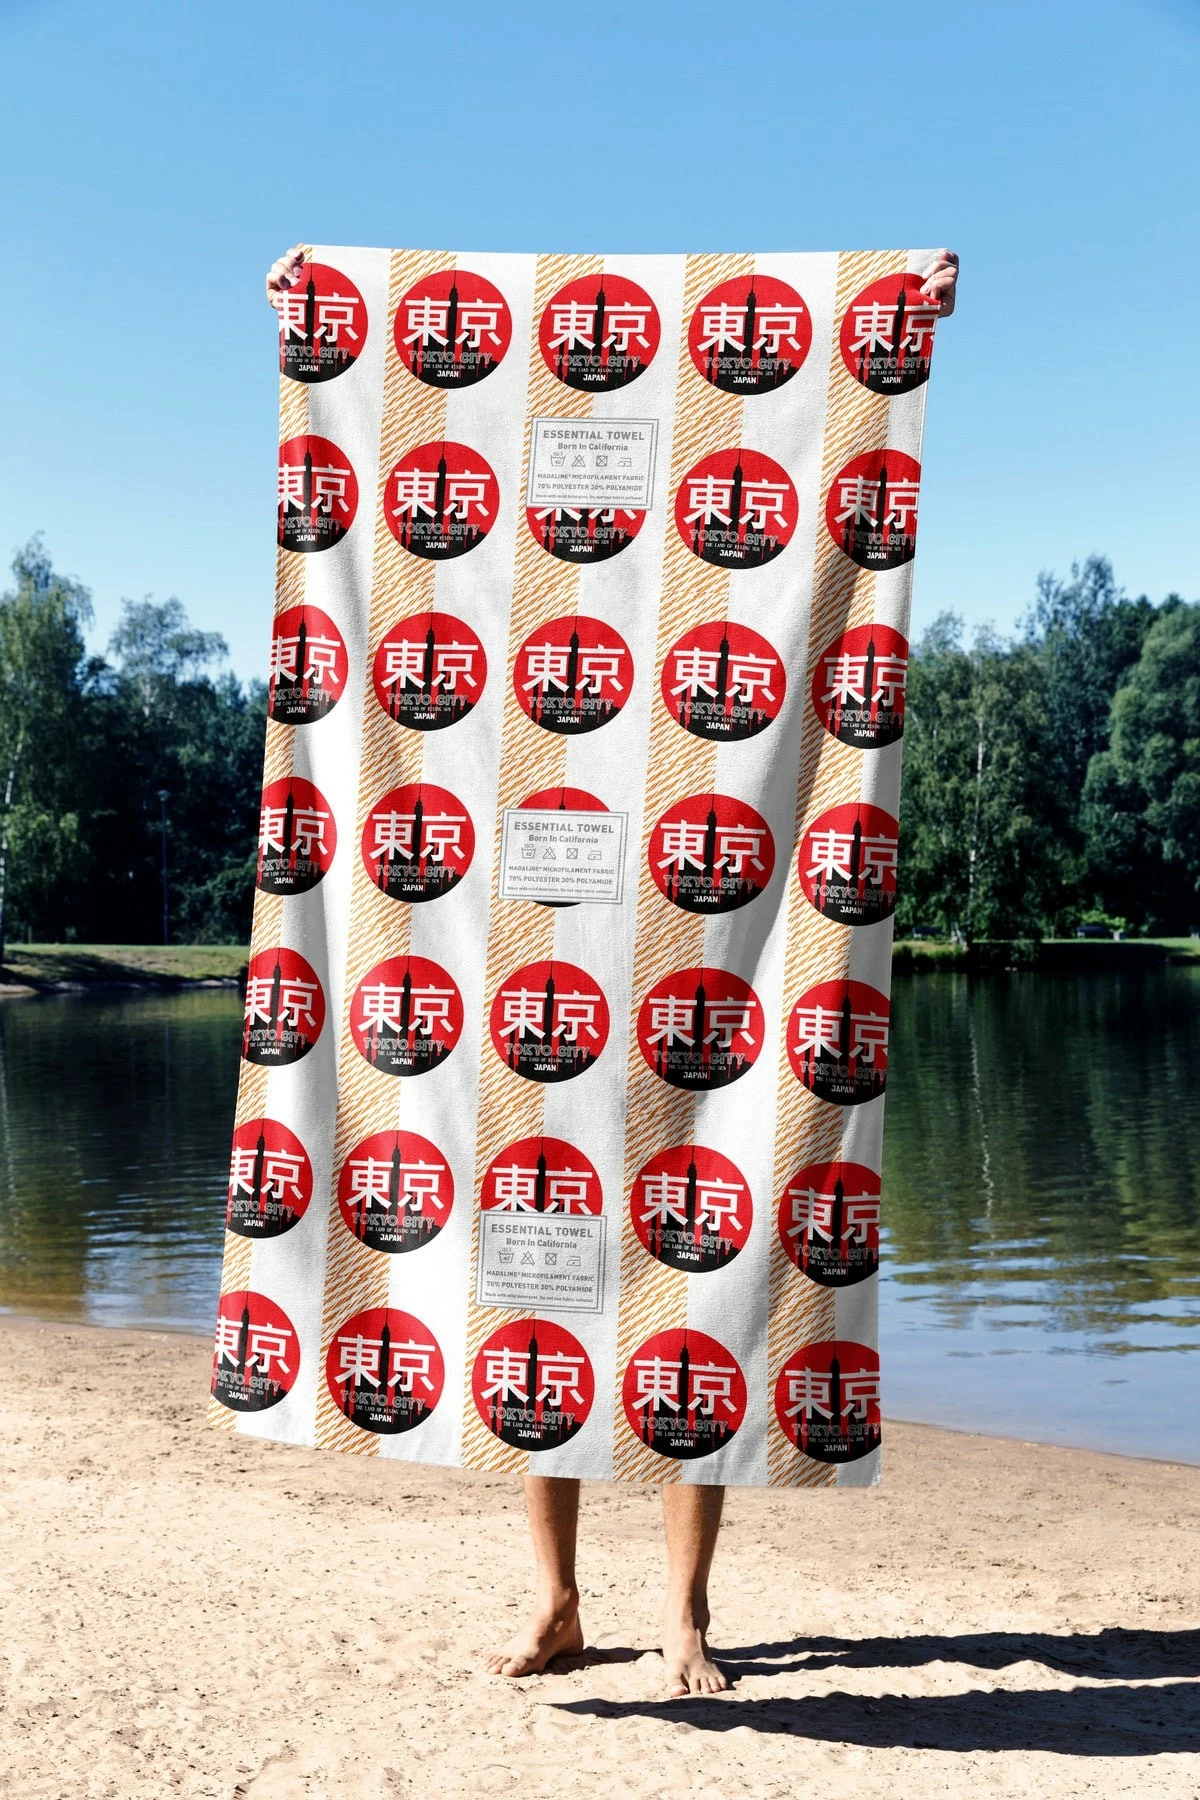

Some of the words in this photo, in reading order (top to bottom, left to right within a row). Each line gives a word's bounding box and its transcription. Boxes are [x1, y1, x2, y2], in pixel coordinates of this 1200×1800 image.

[402, 296, 503, 348] 東京
[548, 300, 652, 351] 東京
[697, 302, 803, 353] 東京
[408, 351, 454, 363] TOKYO
[460, 352, 492, 364] CITY
[554, 355, 601, 367] TOKYO
[607, 355, 640, 367] CITY
[703, 358, 752, 369] TOKYO
[758, 358, 792, 370] CITY
[297, 364, 318, 372] JAPAN
[543, 430, 603, 439] ESSENTIAL
[608, 432, 644, 440] TOWEL
[392, 468, 490, 519] 東京
[684, 474, 790, 529] 東京
[398, 522, 443, 534] TOKYO
[448, 523, 480, 535] CITY
[540, 526, 588, 538] TOKYO
[594, 527, 627, 539] CITY
[296, 535, 315, 543] JAPAN
[690, 529, 738, 544] TOKYO
[744, 532, 778, 546] CITY
[720, 550, 743, 559] JAPAN
[866, 551, 886, 559] JAPAN
[380, 638, 478, 690] 東京
[522, 642, 625, 694] 東京
[670, 647, 777, 702] 東京
[386, 694, 431, 706] TOKYO
[436, 694, 468, 706] CITY
[528, 697, 575, 709] TOKYO
[581, 698, 614, 710] CITY
[676, 701, 725, 717] TOKYO
[731, 706, 766, 720] CITY
[706, 722, 730, 732] JAPAN
[854, 730, 874, 738] JAPAN
[514, 822, 573, 832] ESSENTIAL
[577, 824, 614, 833] TOWEL
[369, 810, 466, 861] 東京
[657, 820, 766, 873] 東京
[375, 865, 419, 877] TOKYO
[425, 866, 456, 878] CITY
[276, 877, 293, 886] JAPAN
[663, 875, 714, 889] TOKYO
[720, 877, 755, 891] CITY
[694, 895, 718, 904] JAPAN
[840, 905, 861, 914] JAPAN
[358, 982, 455, 1035] 東京
[498, 987, 600, 1041] 東京
[645, 994, 756, 1048] 東京
[363, 1038, 408, 1051] TOKYO
[413, 1039, 445, 1052] CITY
[505, 1043, 552, 1057] TOKYO
[557, 1045, 590, 1058] CITY
[261, 1048, 280, 1057] JAPAN
[652, 1051, 703, 1064] TOKYO
[709, 1052, 745, 1065] CITY
[391, 1058, 412, 1066] JAPAN
[534, 1063, 556, 1072] JAPAN
[831, 1084, 854, 1094] JAPAN
[346, 1156, 445, 1211] 東京
[640, 1171, 744, 1230] 東京
[244, 1219, 264, 1229] JAPAN
[352, 1213, 397, 1227] TOKYO
[403, 1215, 435, 1229] CITY
[492, 1224, 551, 1235] ESSENTIAL
[556, 1227, 593, 1238] TOWEL
[380, 1234, 402, 1242] JAPAN
[537, 1240, 577, 1248] California
[646, 1229, 694, 1246] TOKYO
[700, 1234, 734, 1250] CITY
[676, 1252, 699, 1262] JAPAN
[823, 1266, 845, 1275] JAPAN
[335, 1333, 436, 1392] 東京
[481, 1346, 585, 1406] 東京
[632, 1356, 737, 1415] 東京
[228, 1391, 249, 1402] JAPAN
[341, 1390, 387, 1407] TOKYO
[393, 1395, 425, 1411] CITY
[369, 1413, 392, 1423] JAPAN
[488, 1406, 536, 1422] TOKYO
[541, 1410, 575, 1426] CITY
[639, 1416, 688, 1432] TOKYO
[693, 1419, 728, 1434] CITY
[518, 1429, 541, 1439] JAPAN
[670, 1438, 693, 1448] JAPAN
